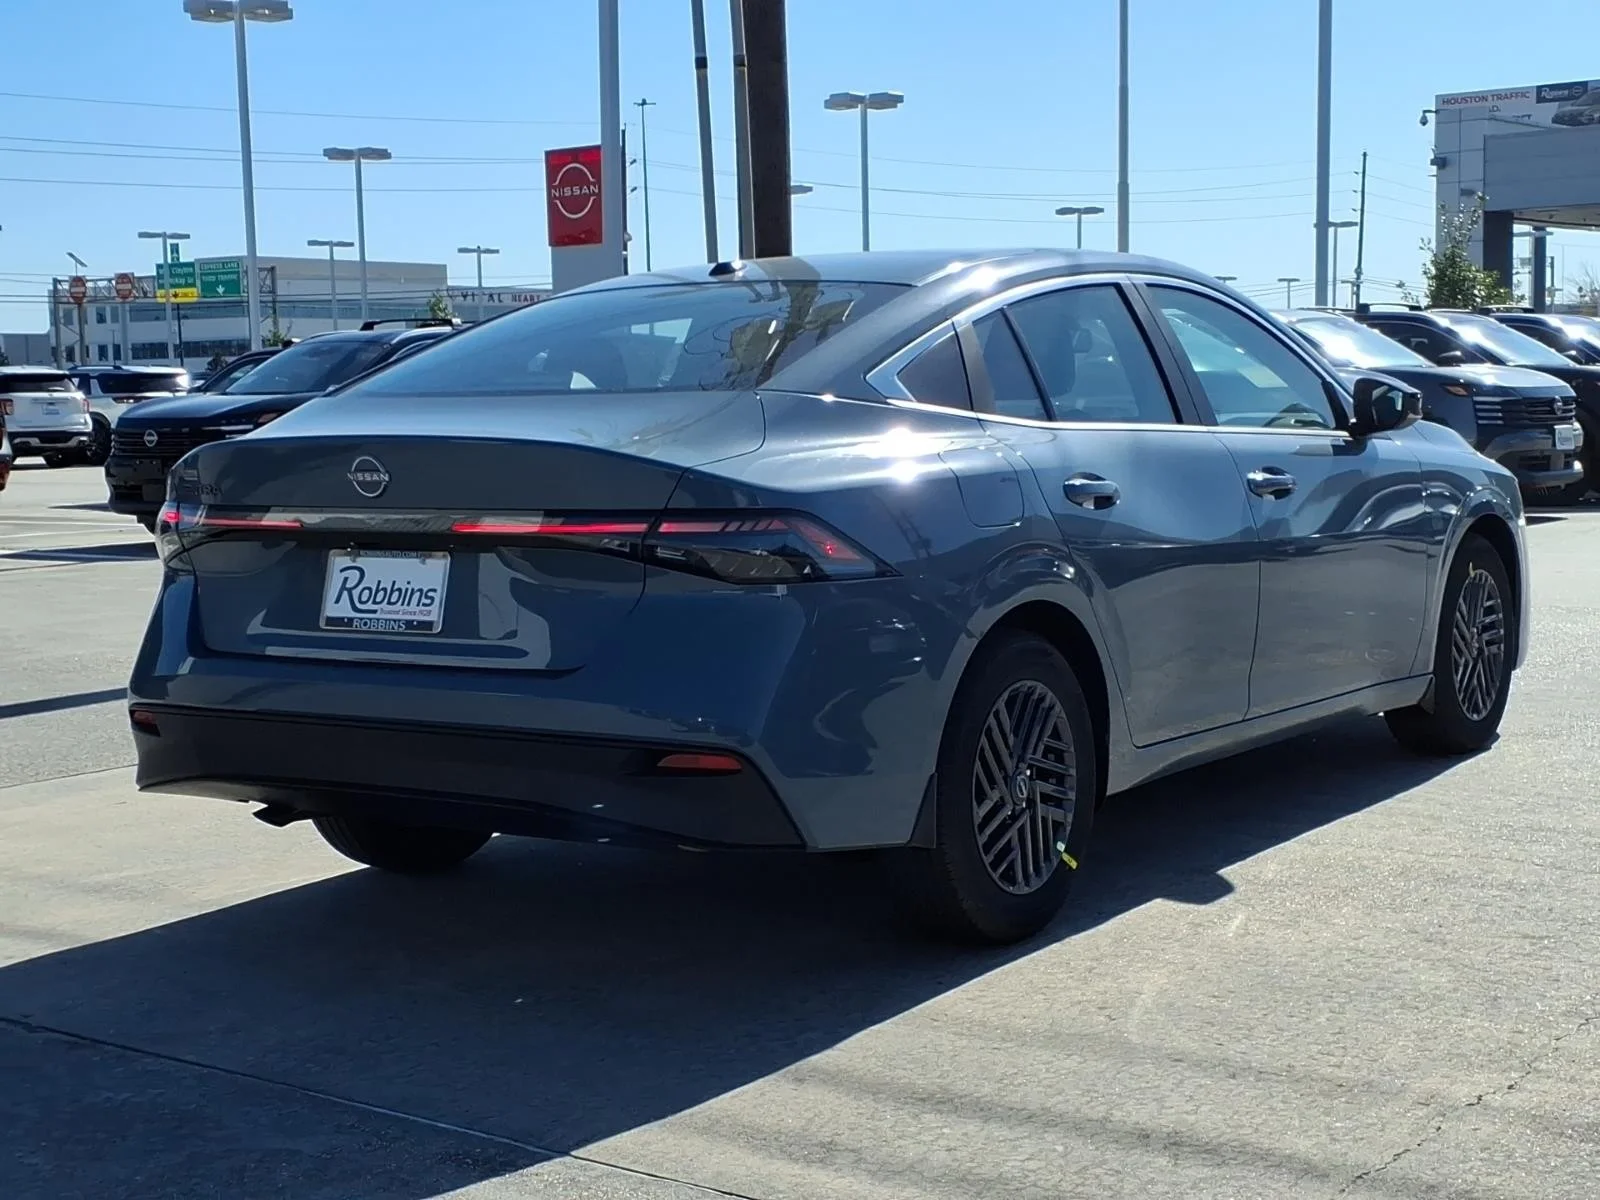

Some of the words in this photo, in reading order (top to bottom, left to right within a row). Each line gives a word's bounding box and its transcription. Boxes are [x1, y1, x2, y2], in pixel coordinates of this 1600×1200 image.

[1441, 95, 1489, 105] HOUSTON
[1491, 91, 1531, 102] TRAFFIC
[551, 184, 599, 197] NISSAN
[461, 291, 503, 303] VIAL
[347, 472, 390, 482] NISSAN
[334, 565, 437, 614] Robbins
[352, 618, 406, 631] ROBBINS
